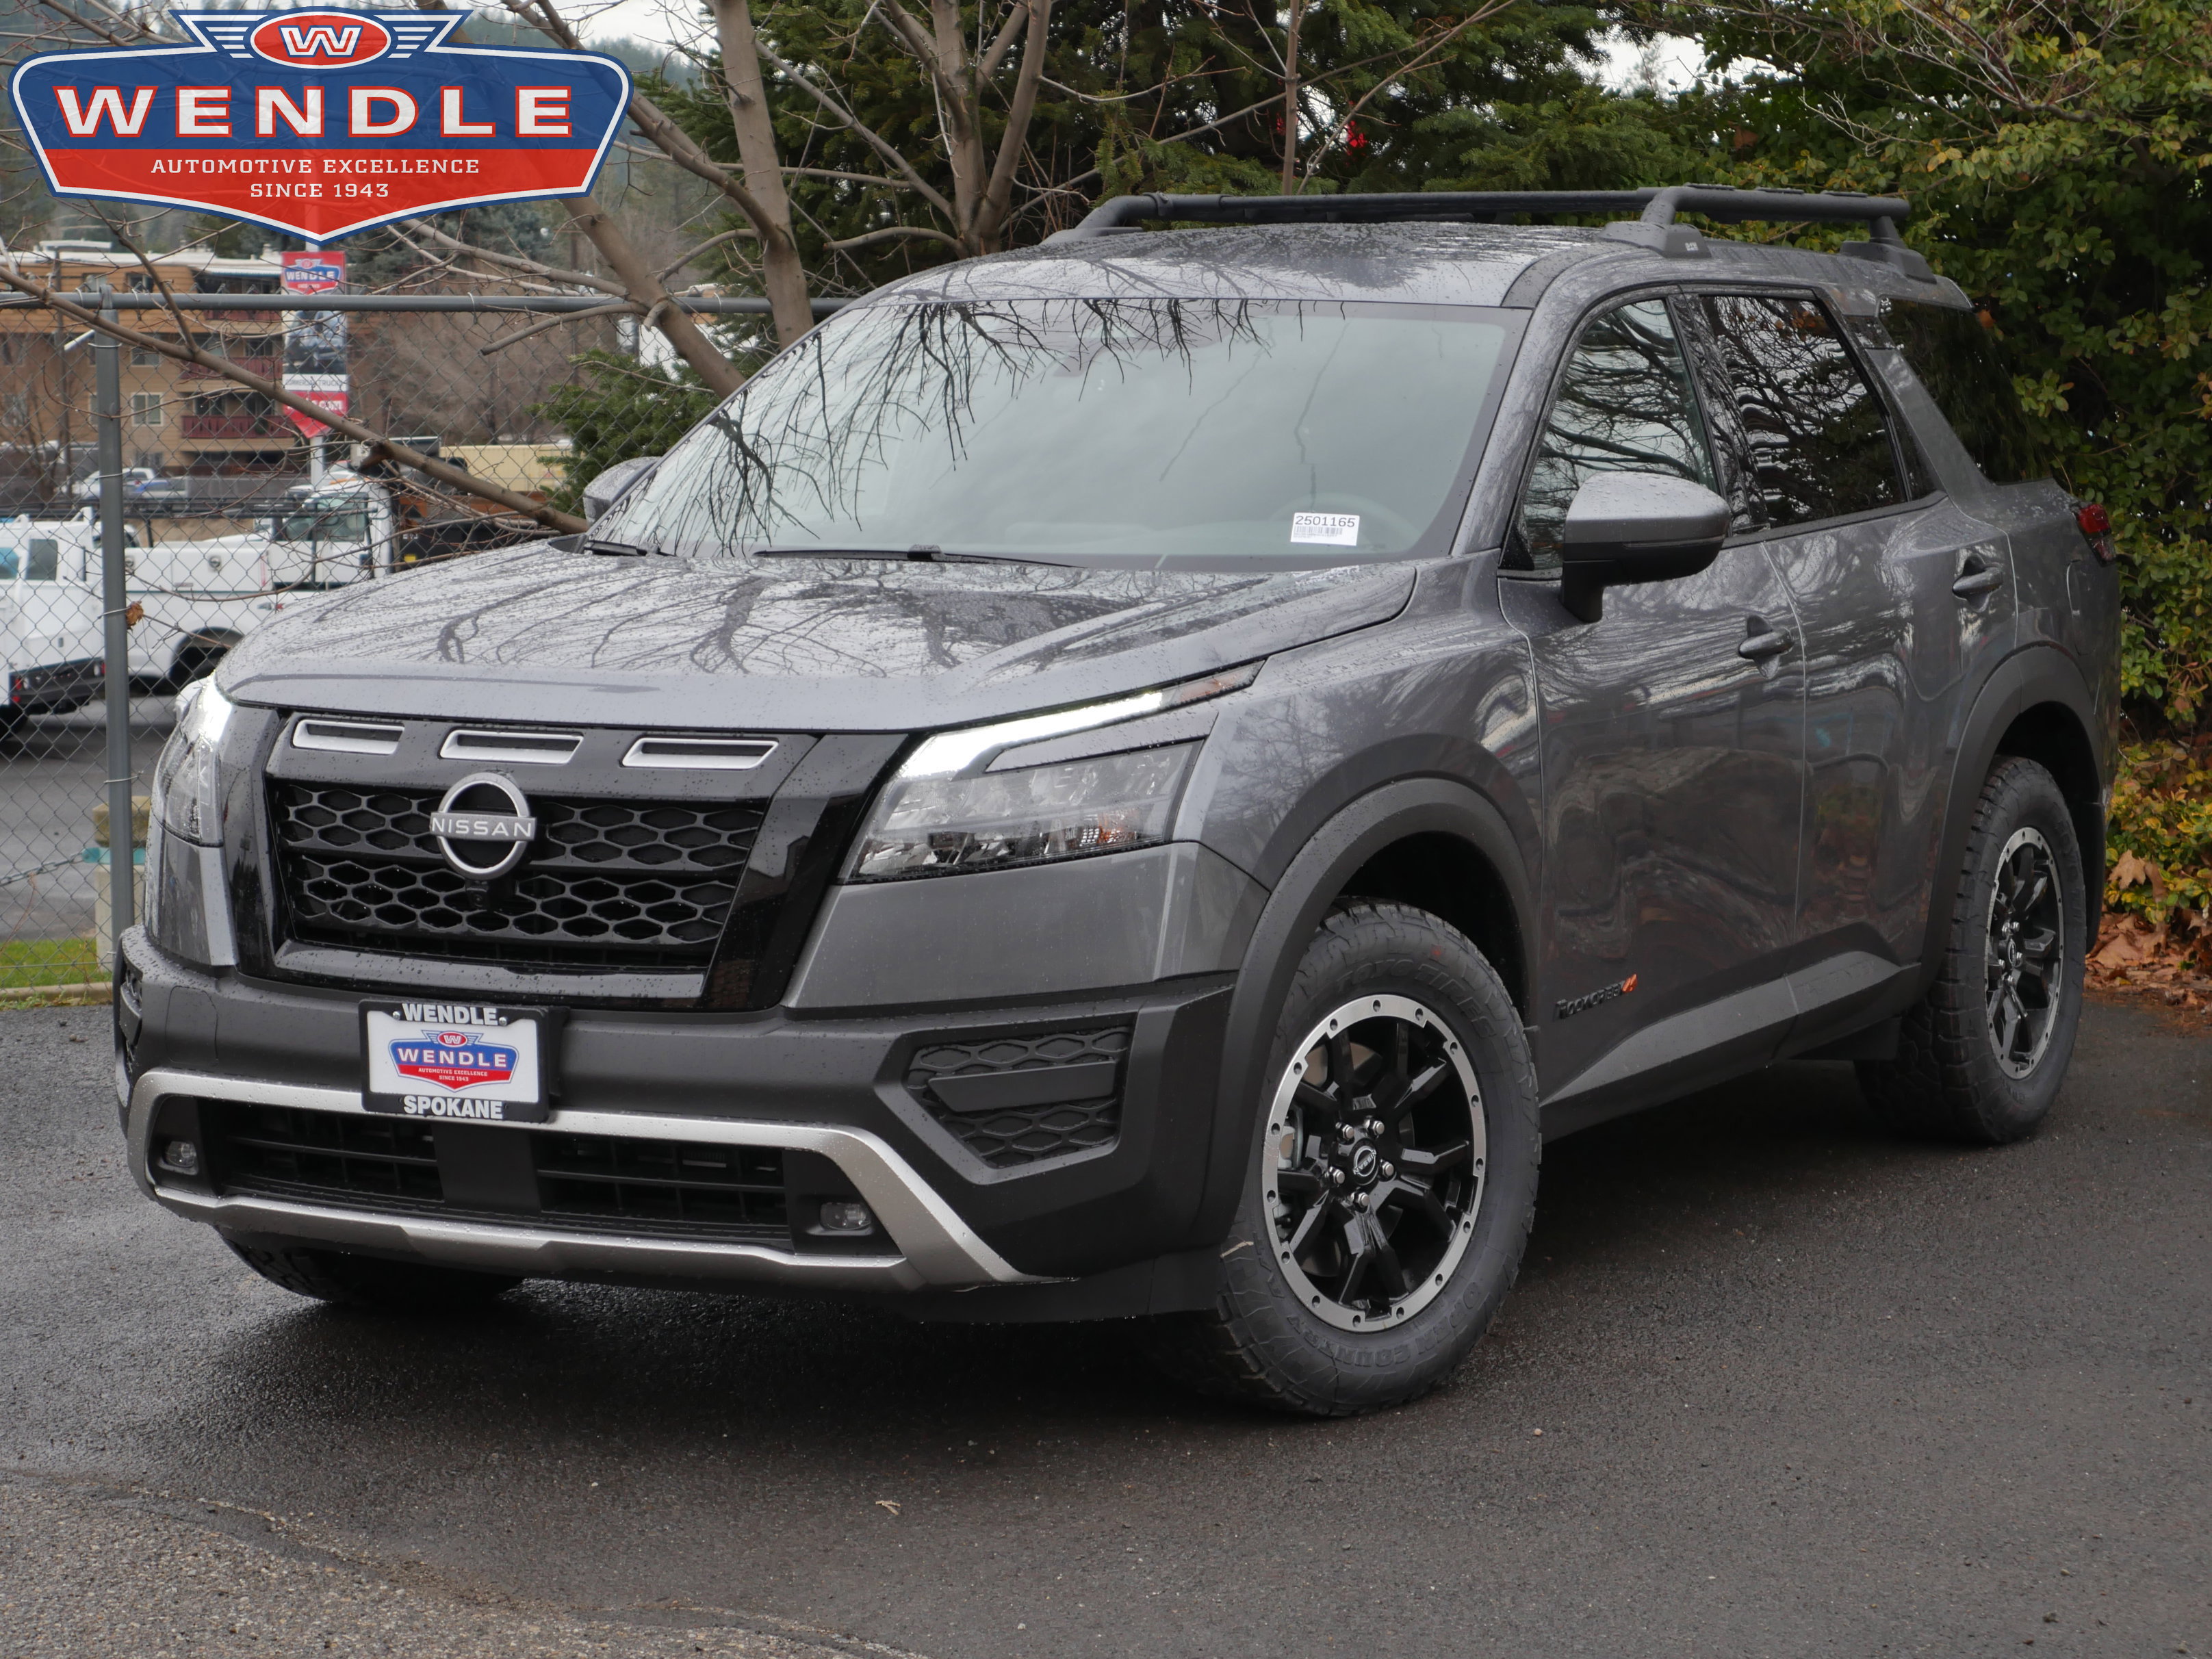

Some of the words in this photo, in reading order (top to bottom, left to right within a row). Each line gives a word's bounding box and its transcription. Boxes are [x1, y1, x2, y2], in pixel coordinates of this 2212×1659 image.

[286, 271, 335, 281] WENDLE
[1295, 515, 1356, 528] 2501165
[432, 817, 532, 837] NISSAN
[1415, 962, 1497, 1038] TIRES
[402, 1003, 499, 1025] WENDLE
[398, 1048, 506, 1067] WENDLE
[403, 1095, 503, 1119] SPOKANE
